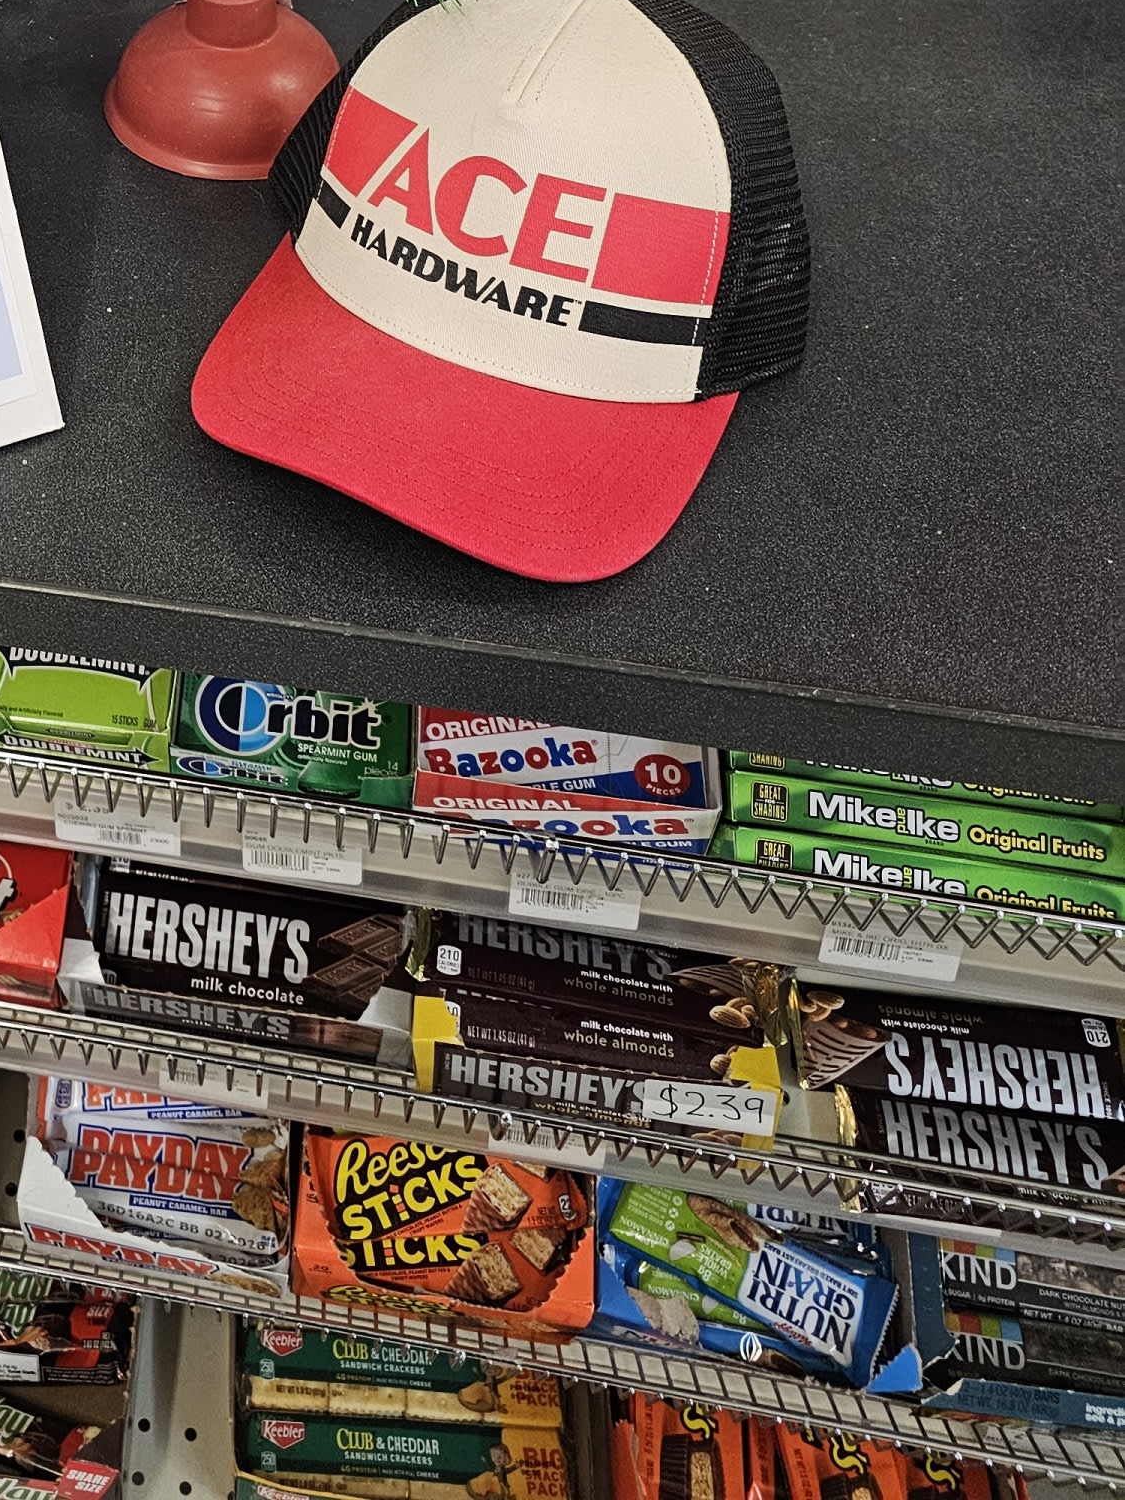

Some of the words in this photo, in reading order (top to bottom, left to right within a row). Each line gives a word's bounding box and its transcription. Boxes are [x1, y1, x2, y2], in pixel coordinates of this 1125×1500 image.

[368, 126, 608, 283] ACE
[350, 213, 576, 328] HARDWARE
[195, 675, 382, 756] Orbit
[4, 734, 143, 764] DOUBLEMINT
[297, 743, 351, 759] SPEARMINT
[353, 750, 378, 763] GUM
[426, 737, 598, 778] Bazooka
[644, 762, 682, 785] 10
[433, 796, 581, 811] ORIGINAL
[807, 790, 897, 829] Mike
[897, 807, 909, 835] and
[907, 808, 960, 842] Ike
[968, 826, 1047, 853] Original
[1052, 838, 1107, 862] Fruits
[104, 891, 311, 984] HERSHEY'S
[190, 975, 224, 993] milk
[228, 981, 305, 1006] chocolate
[884, 1031, 1106, 1119] HERSHEY'S
[652, 1082, 765, 1124] $2.39
[881, 1099, 1109, 1191] HERSHEY'S
[342, 1155, 484, 1240] STICKS
[29, 1226, 220, 1276] PAYDAY
[753, 1250, 856, 1321] GRAIN
[746, 1278, 852, 1354] NUTRI
[262, 1420, 305, 1441] Keebler
[336, 1427, 374, 1451] CLUB
[376, 1436, 386, 1450] &
[386, 1435, 441, 1456] CHEDDAR
[65, 1468, 110, 1485] SHARE
[343, 1450, 389, 1463] SANDWICH
[390, 1453, 433, 1466] CRACKERS
[74, 1478, 105, 1493] SIZE
